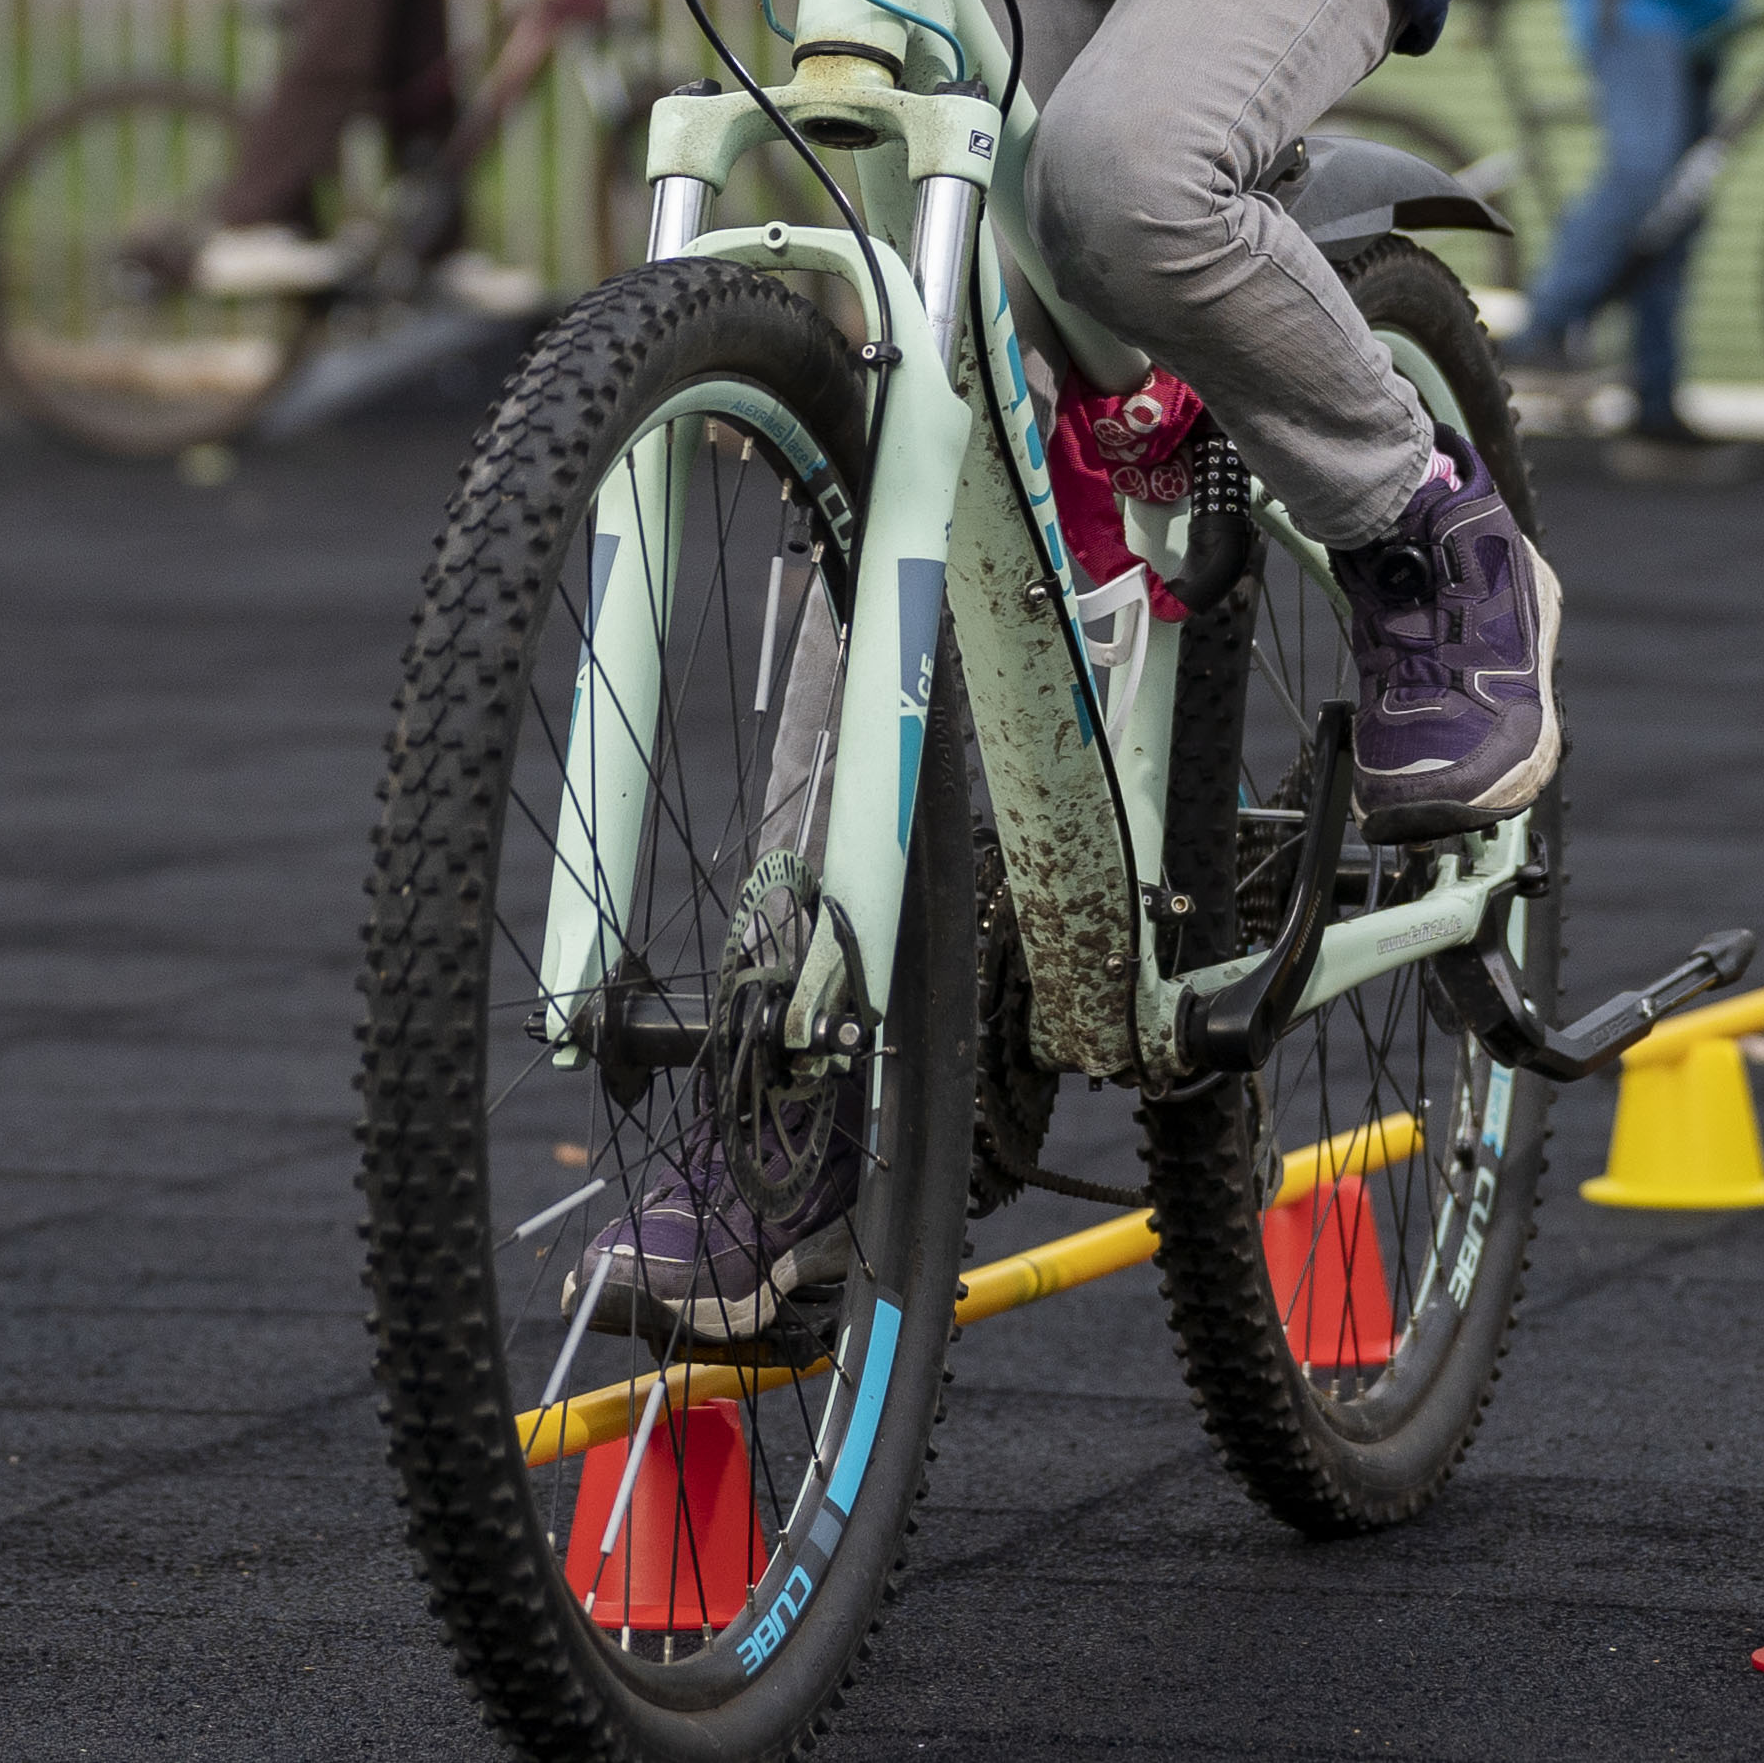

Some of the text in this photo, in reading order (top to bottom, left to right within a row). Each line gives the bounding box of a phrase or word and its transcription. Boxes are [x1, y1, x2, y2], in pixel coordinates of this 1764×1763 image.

[817, 482, 852, 551] CU
[1447, 1166, 1497, 1311] CUBE
[735, 1564, 813, 1677] CUBE
